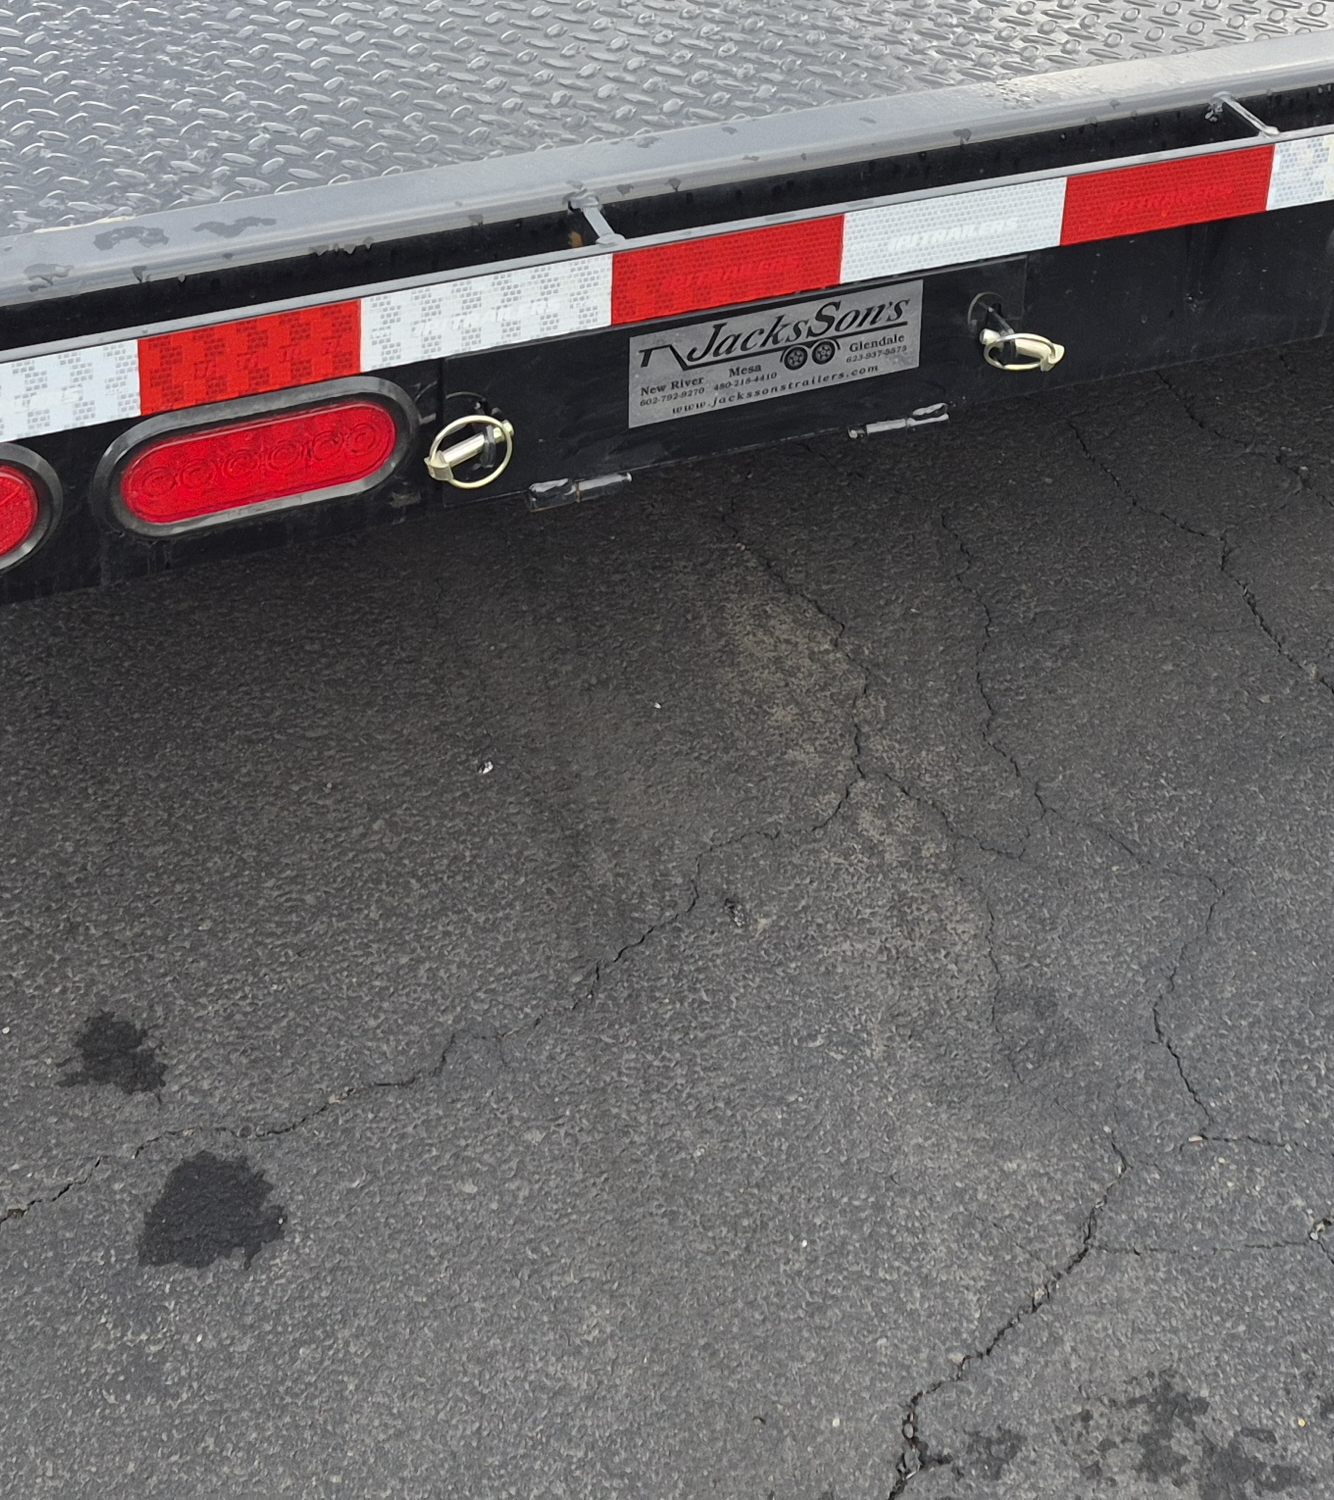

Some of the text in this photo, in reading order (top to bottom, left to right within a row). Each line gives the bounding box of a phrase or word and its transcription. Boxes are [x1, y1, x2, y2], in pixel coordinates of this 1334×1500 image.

[686, 299, 911, 362] JacksSon's
[849, 333, 905, 352] Glendale
[728, 364, 762, 378] Mesa
[640, 376, 704, 397] New River
[672, 365, 879, 414] www.jackssonstrailers.com
